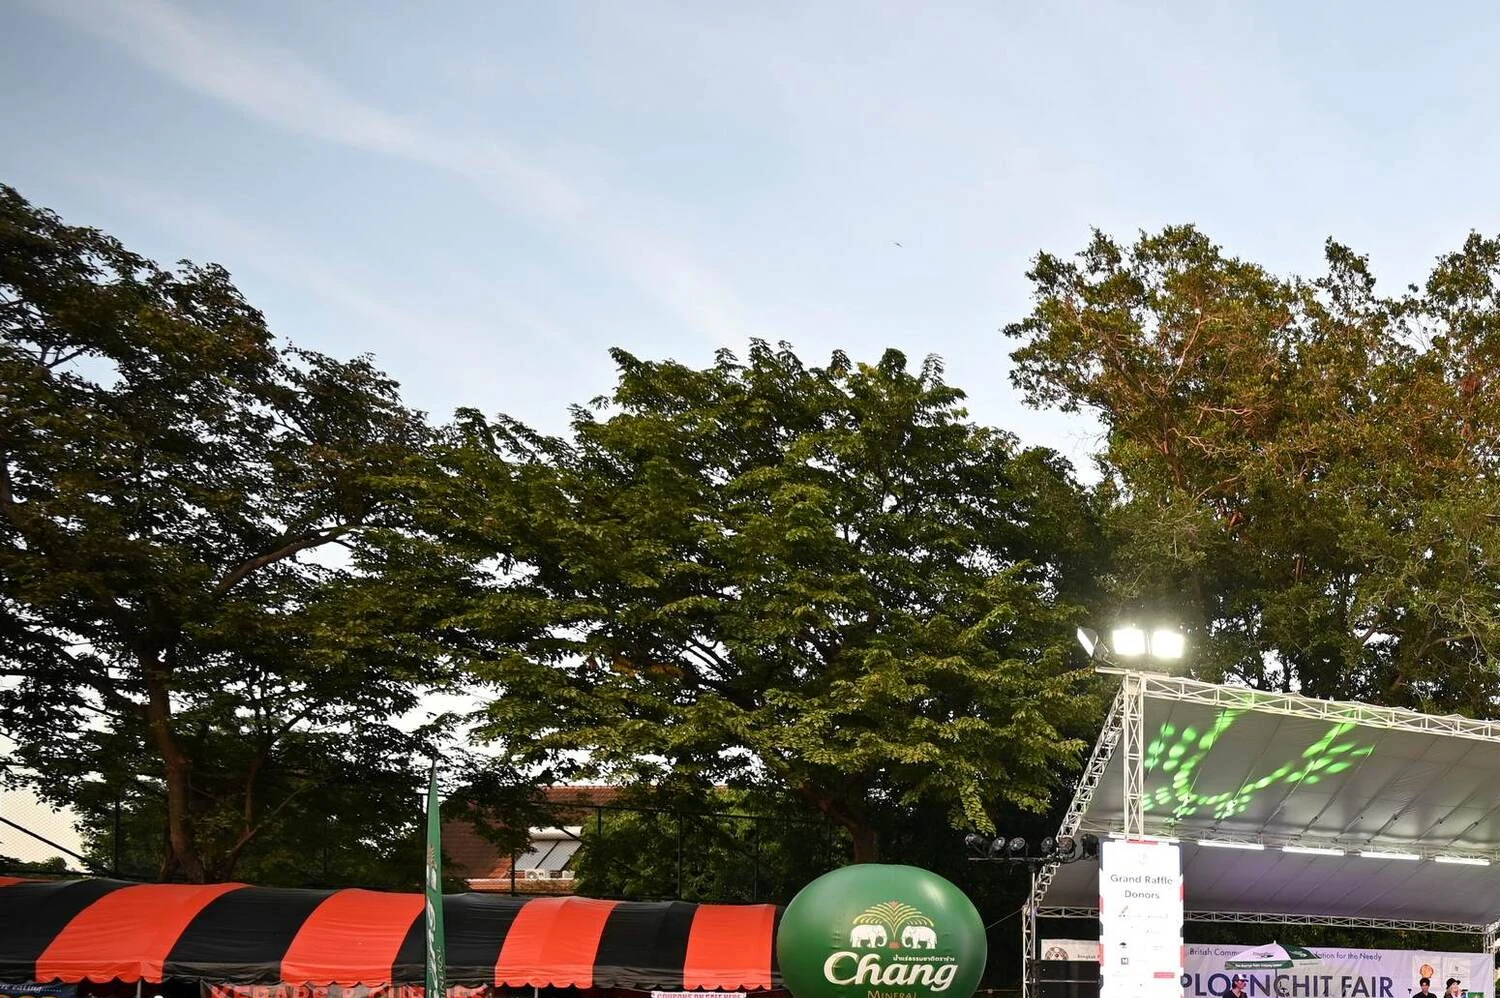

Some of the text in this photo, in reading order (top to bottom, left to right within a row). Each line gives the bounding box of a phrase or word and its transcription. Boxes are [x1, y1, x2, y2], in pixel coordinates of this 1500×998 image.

[1110, 874, 1173, 885] Grand Raffle
[1124, 889, 1160, 899] Donors
[1189, 948, 1212, 956] British
[1348, 952, 1359, 960] the
[1360, 953, 1382, 961] Needy
[823, 951, 959, 992] Chang
[1180, 973, 1394, 998] PLONCHIT FAIR
